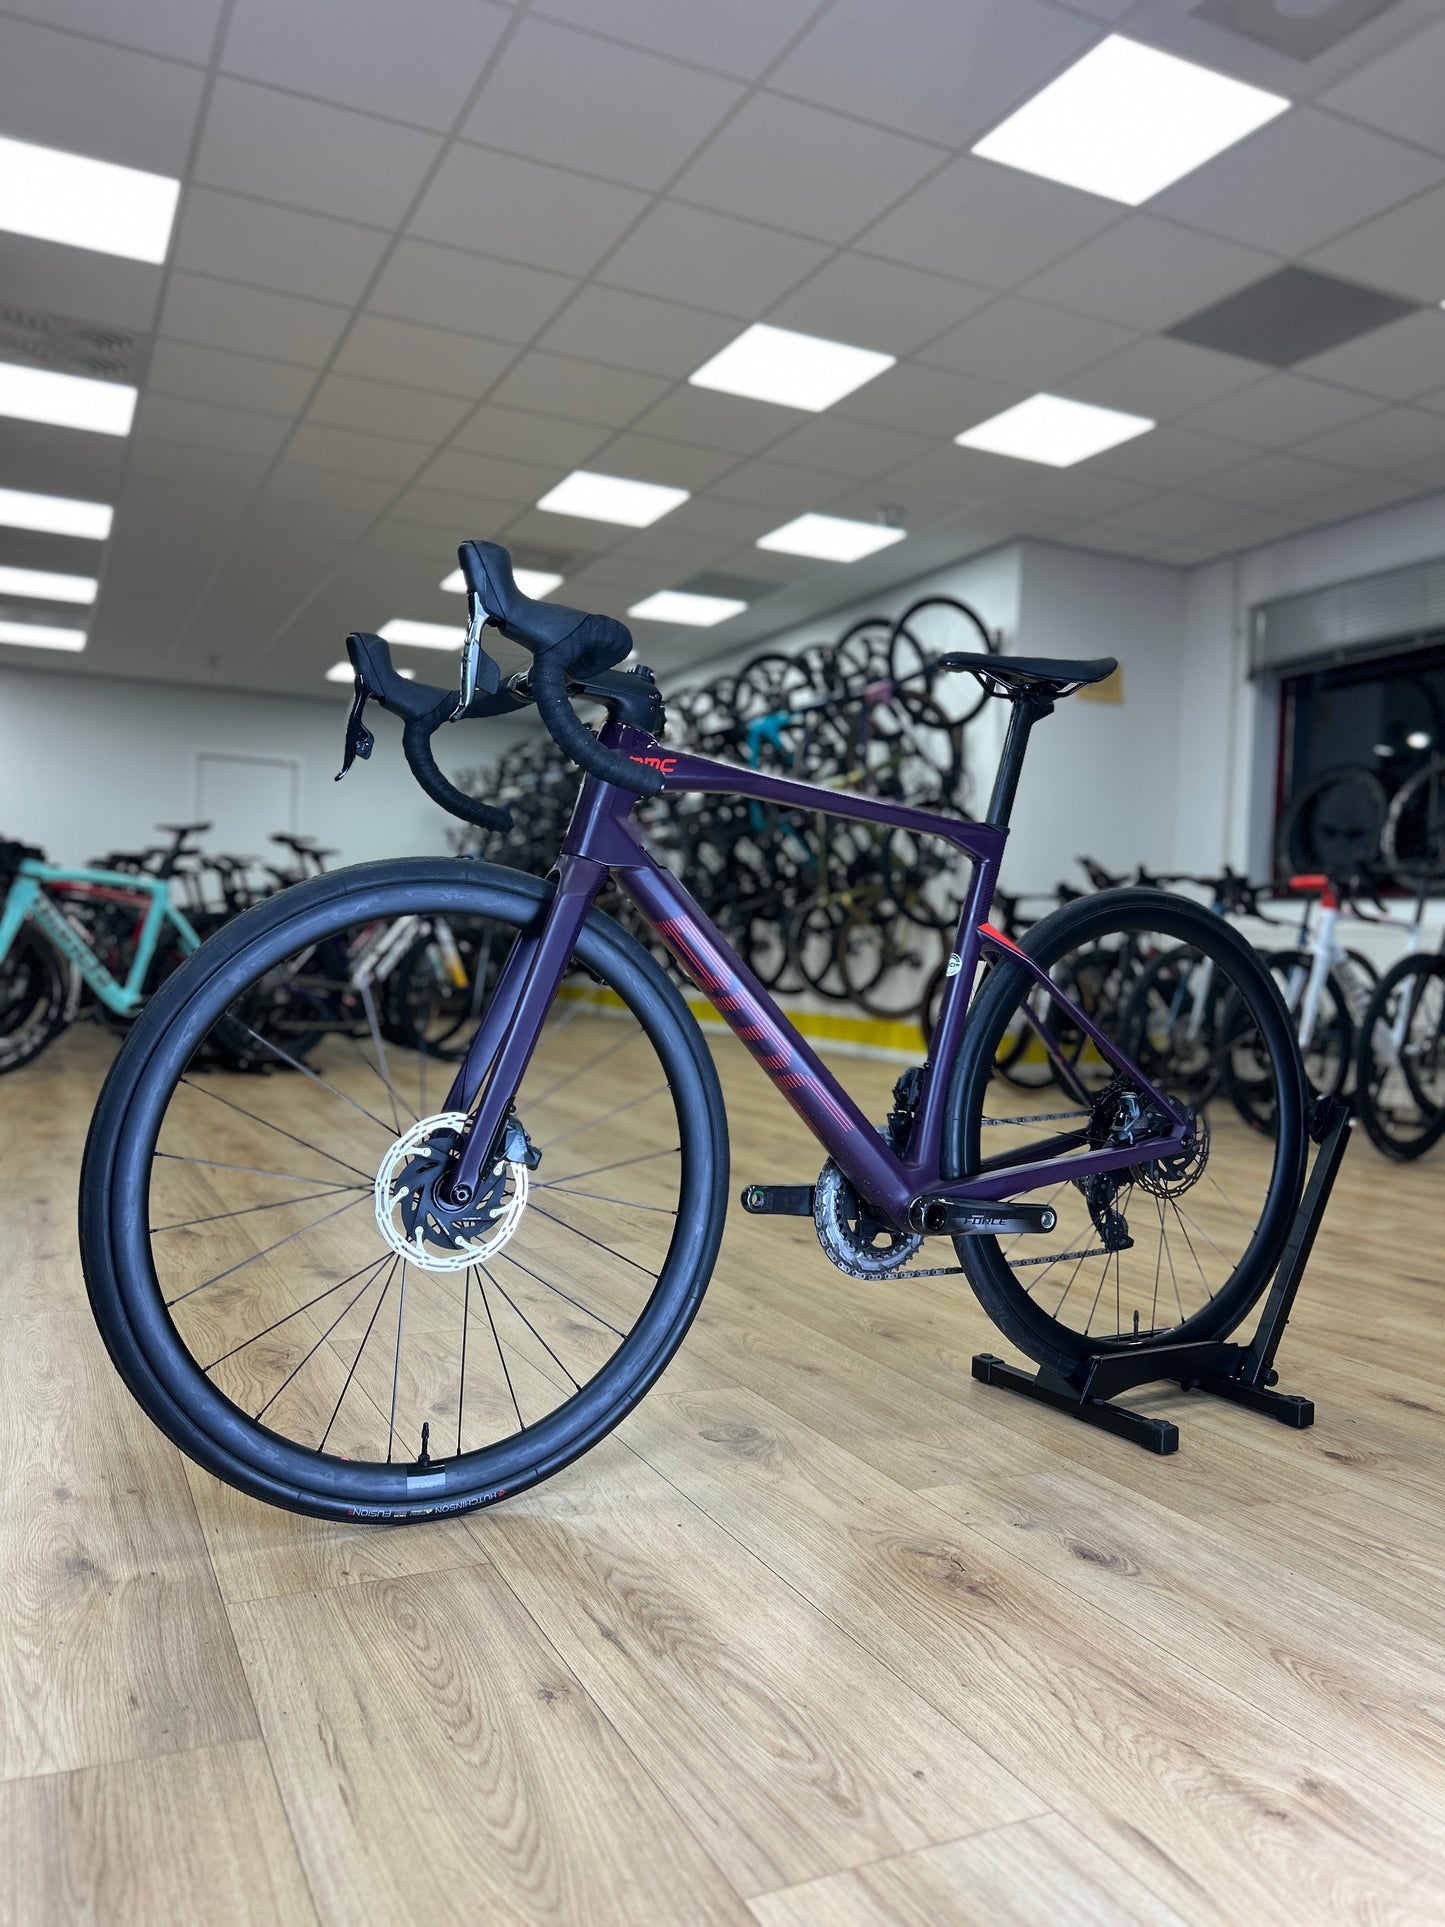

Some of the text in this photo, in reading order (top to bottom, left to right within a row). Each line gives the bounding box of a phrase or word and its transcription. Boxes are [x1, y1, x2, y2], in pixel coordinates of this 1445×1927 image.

[629, 755, 677, 773] MC
[963, 1216, 1008, 1226] FORCE
[434, 1492, 498, 1514] HUTCHINSON
